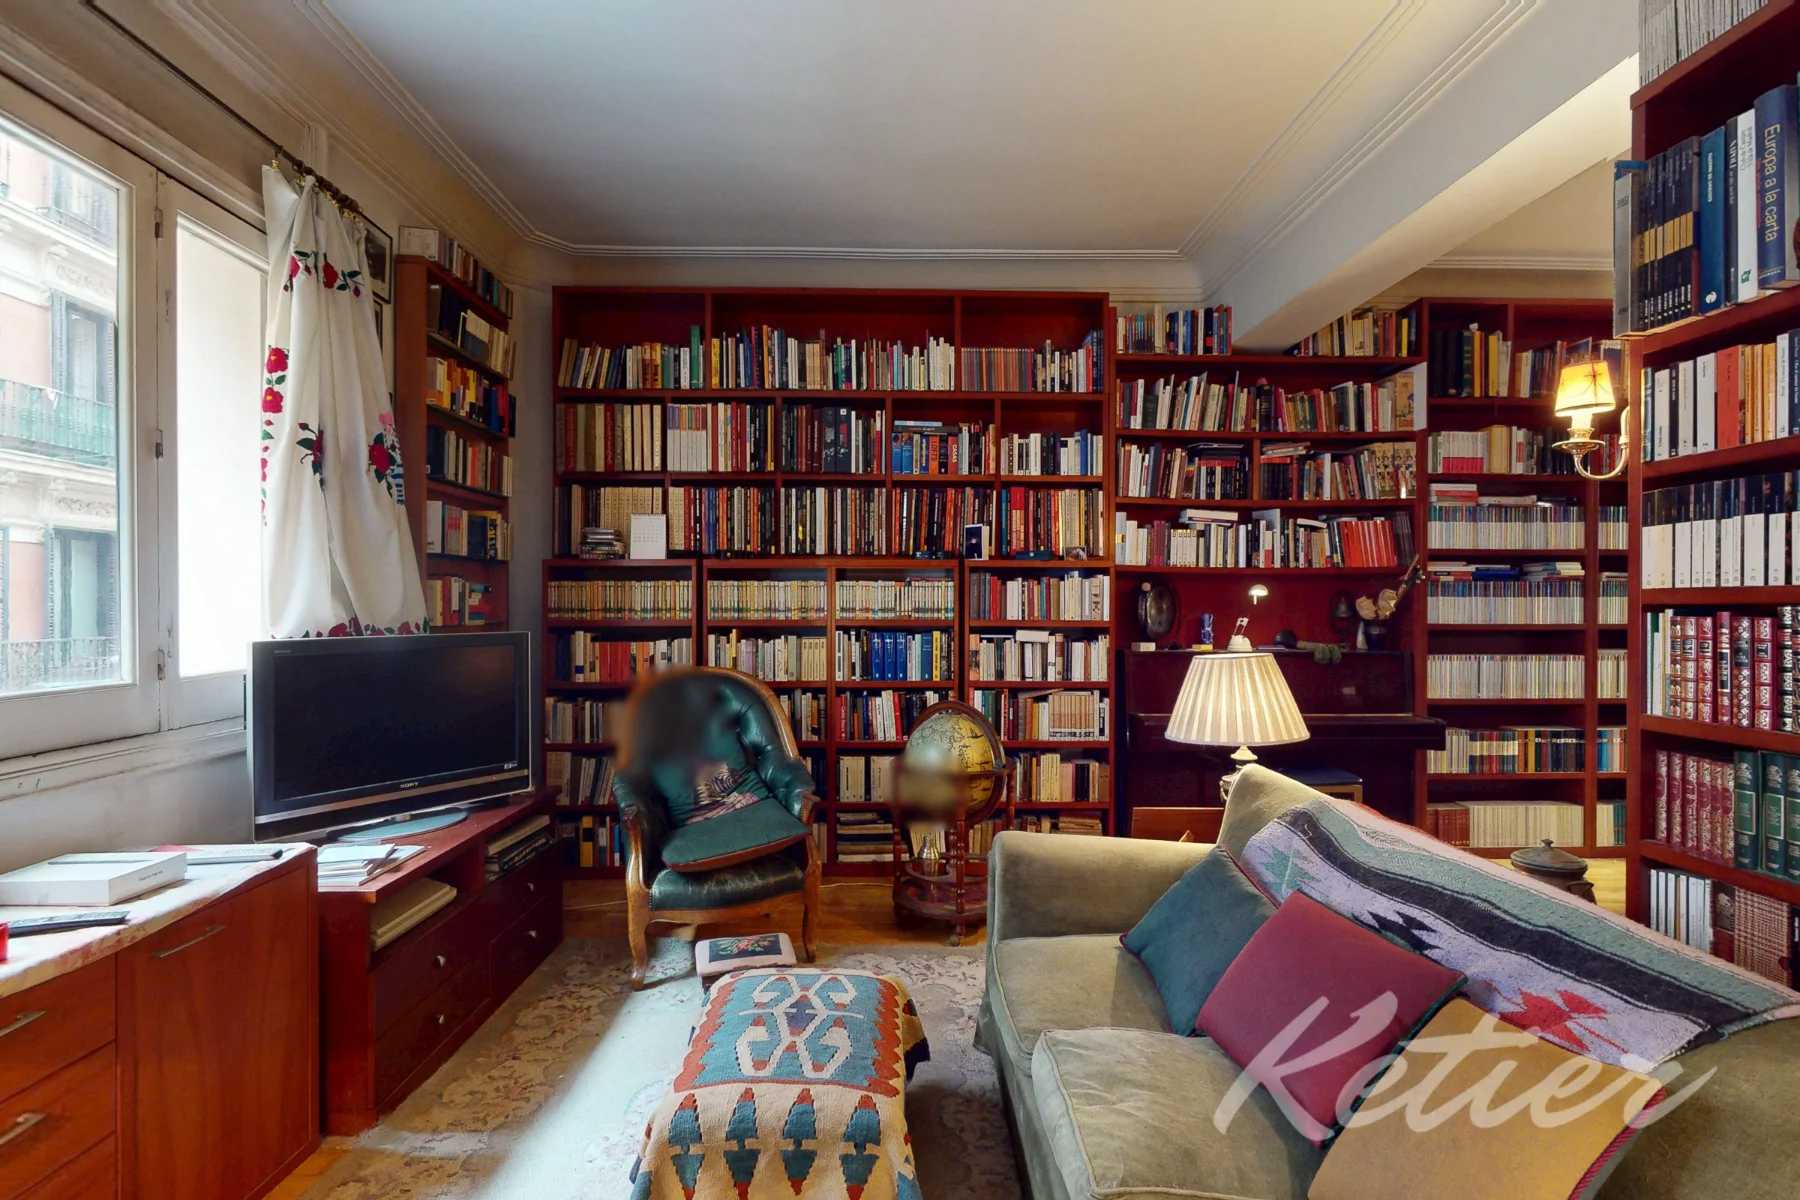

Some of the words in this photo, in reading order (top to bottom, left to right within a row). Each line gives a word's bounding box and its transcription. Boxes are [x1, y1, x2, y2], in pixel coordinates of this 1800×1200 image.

[1762, 123, 1780, 176] Europa
[1764, 178, 1777, 188] a
[1764, 188, 1780, 204] la
[1764, 206, 1780, 242] carta
